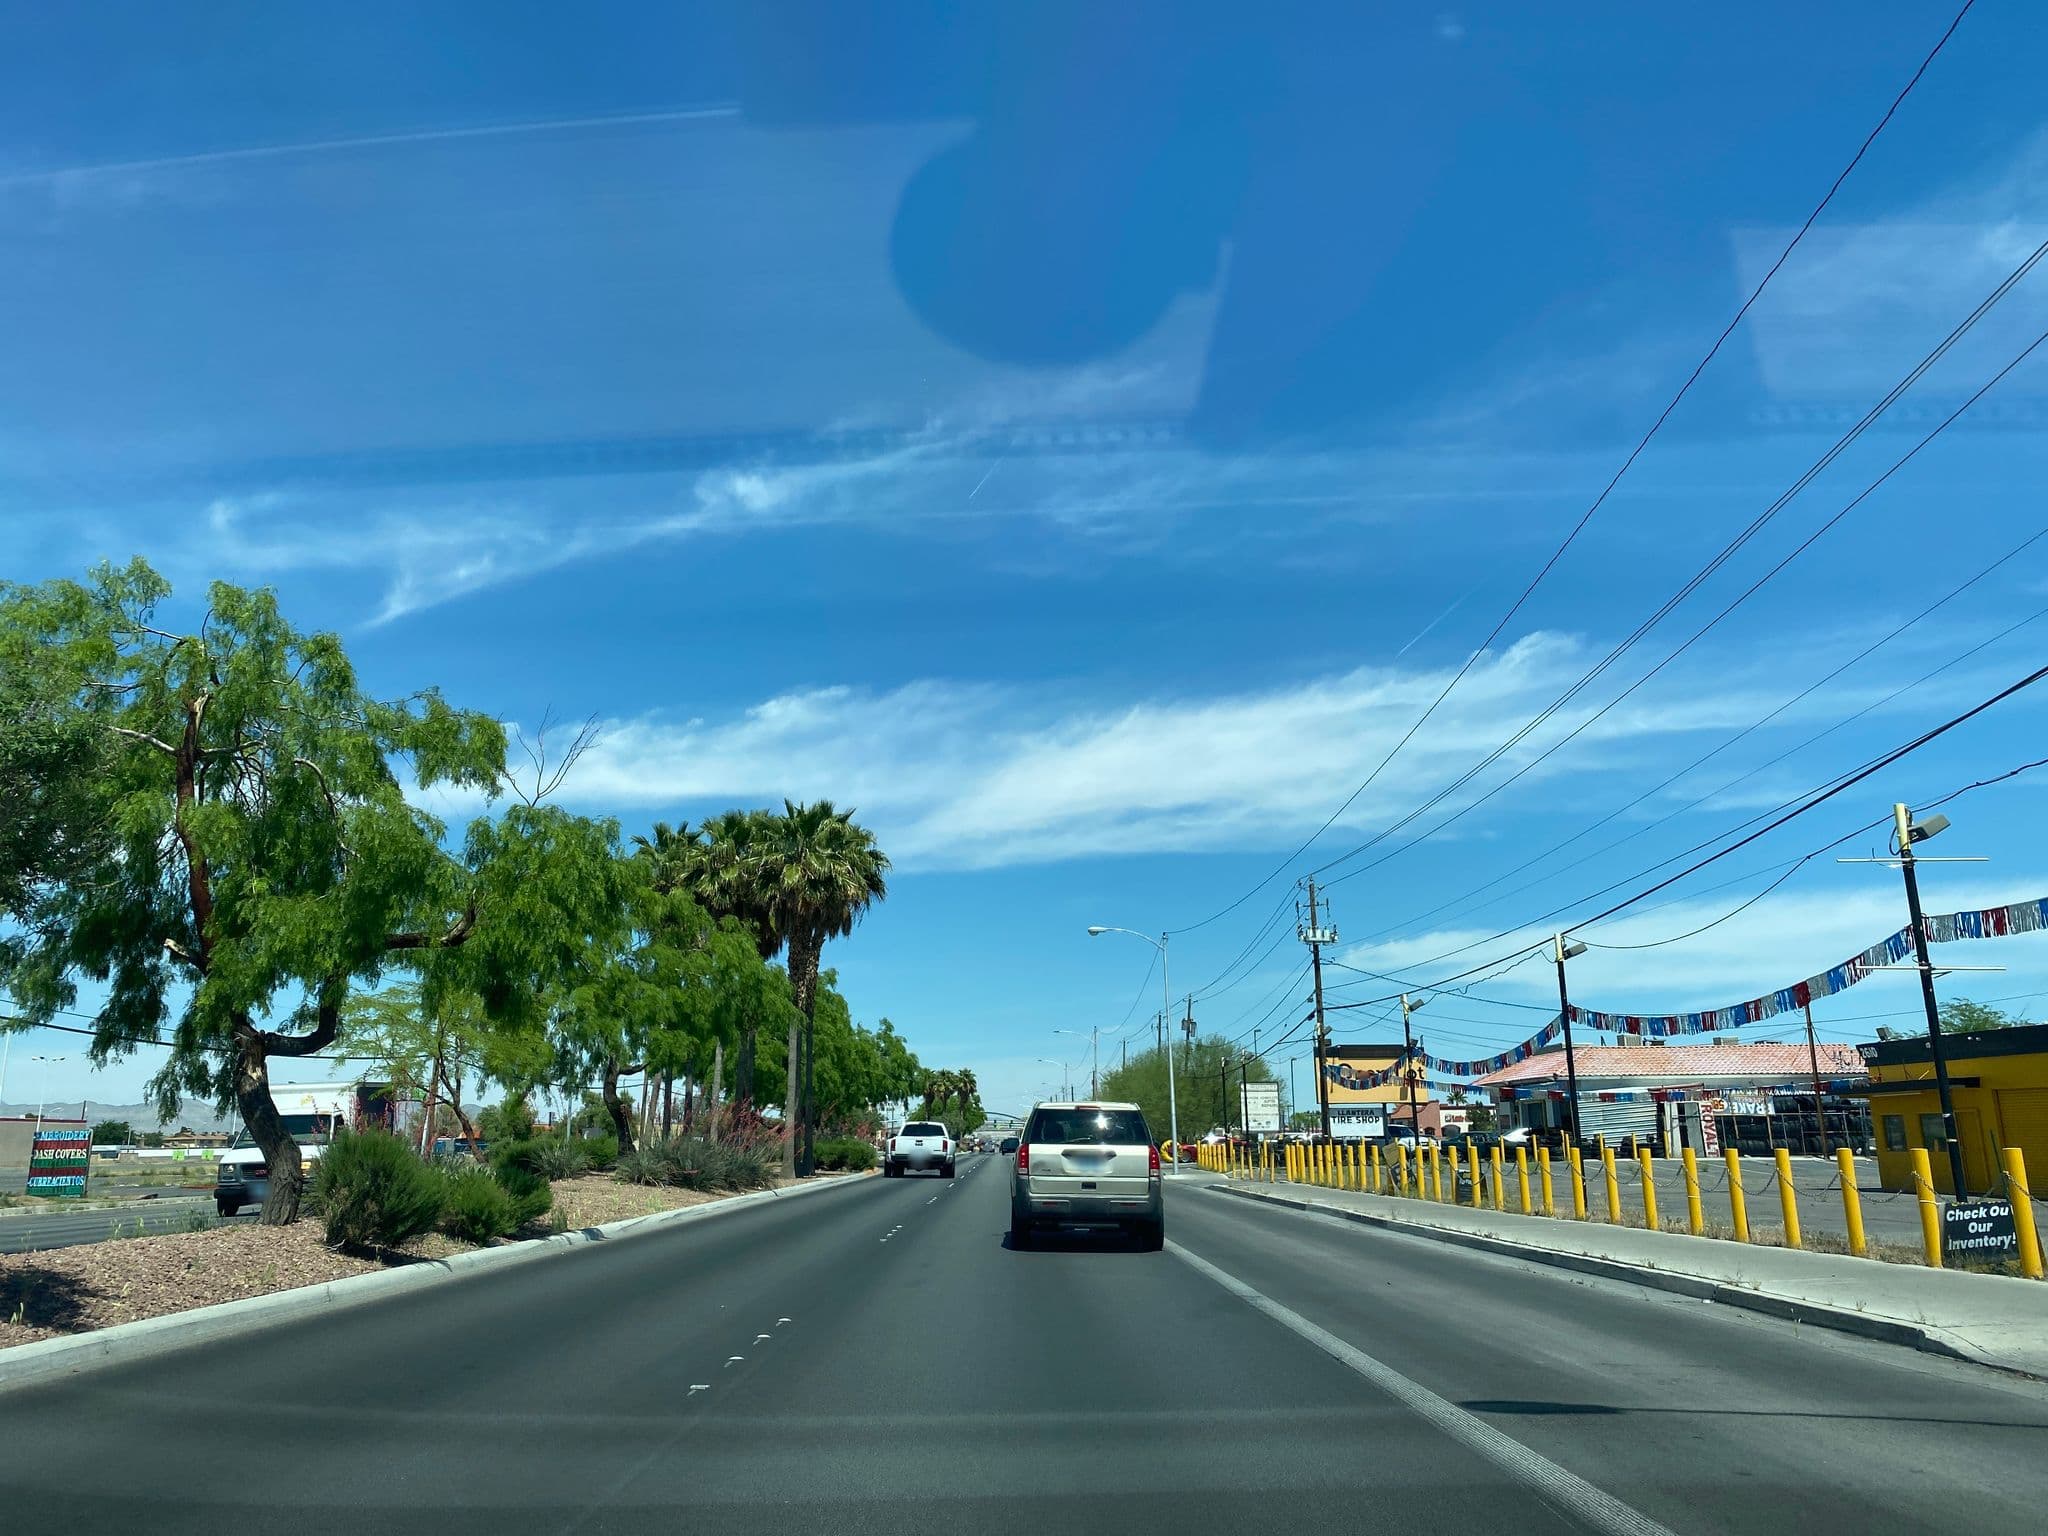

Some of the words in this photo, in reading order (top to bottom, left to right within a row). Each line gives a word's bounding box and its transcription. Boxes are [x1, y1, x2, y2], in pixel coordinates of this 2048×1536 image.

[1860, 1047, 1878, 1058] 2610
[1332, 1116, 1352, 1124] TIRE
[1358, 1116, 1380, 1124] SHOP
[33, 1149, 54, 1159] DASH
[55, 1148, 87, 1159] COVERS
[1946, 1206, 1987, 1222] Check
[1989, 1205, 2014, 1217] Ou
[1968, 1222, 1993, 1234] Our
